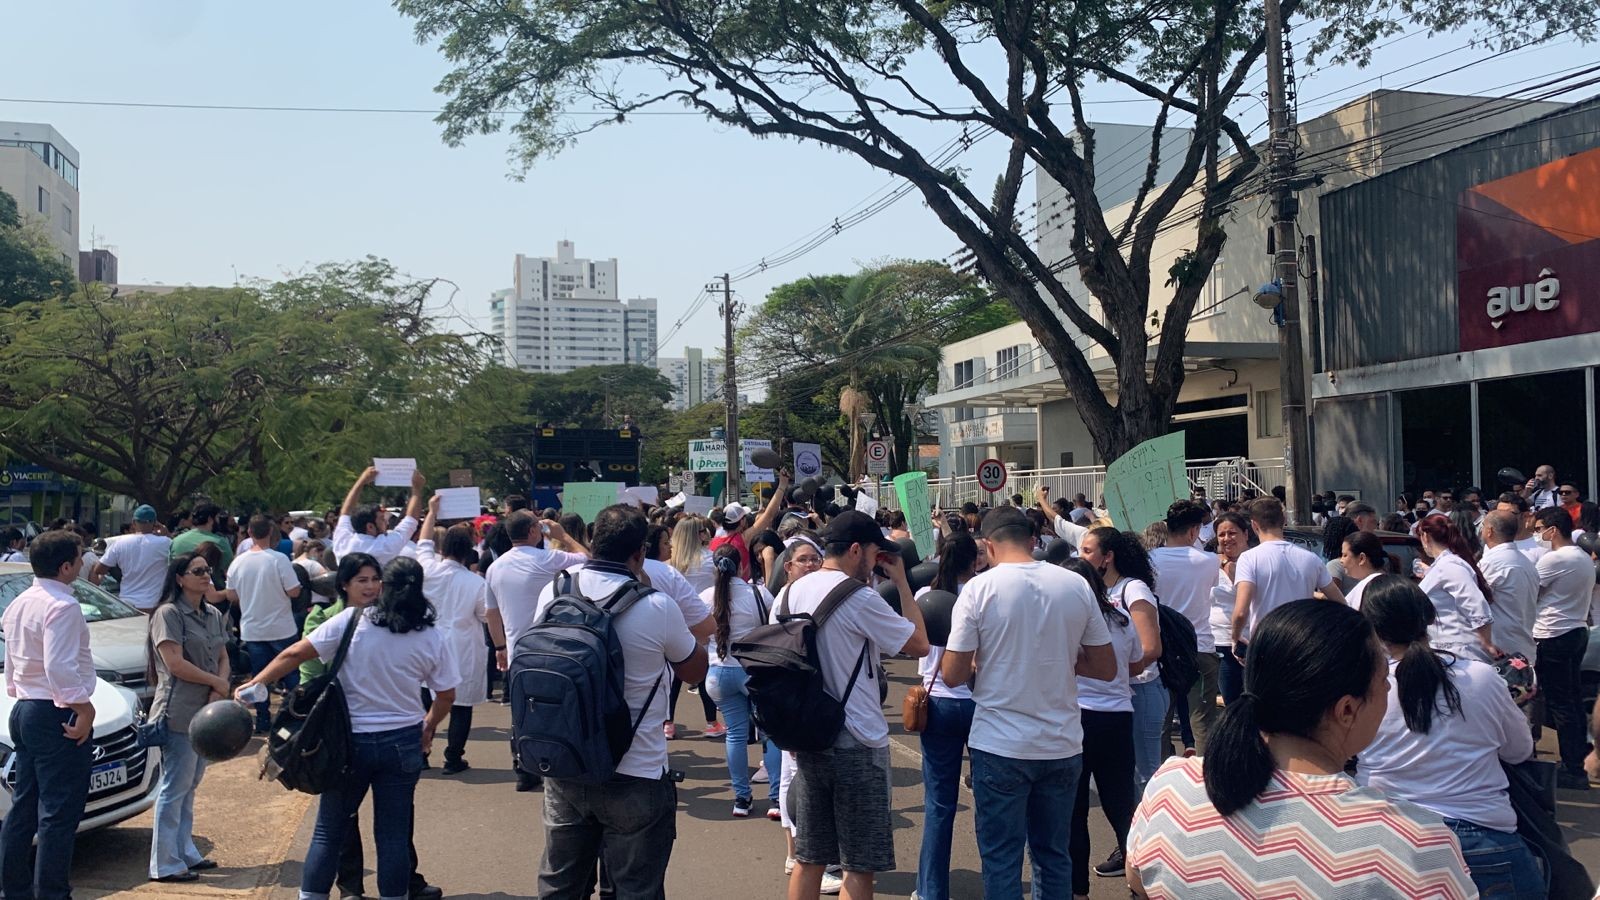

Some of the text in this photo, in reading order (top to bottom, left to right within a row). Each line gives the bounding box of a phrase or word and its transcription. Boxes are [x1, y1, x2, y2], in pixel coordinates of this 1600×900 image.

[874, 447, 882, 456] E
[983, 465, 1000, 479] 30
[90, 770, 121, 790] V5J24
